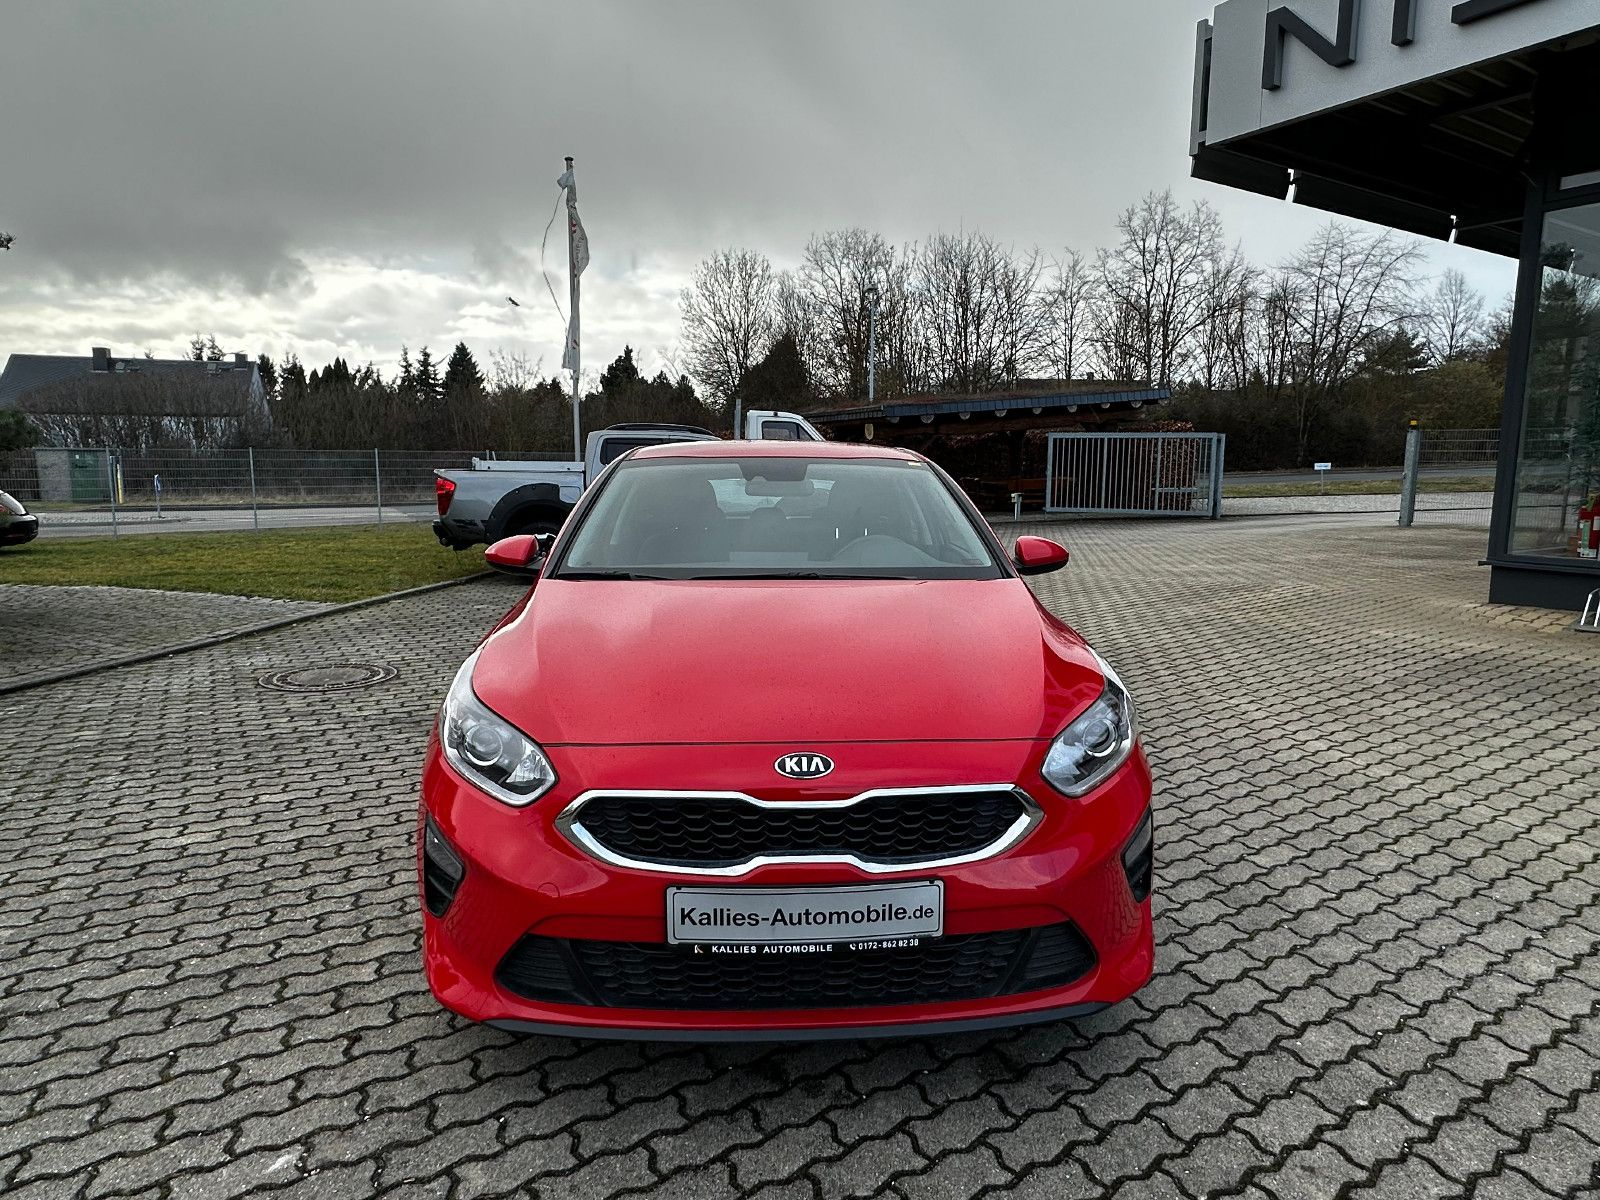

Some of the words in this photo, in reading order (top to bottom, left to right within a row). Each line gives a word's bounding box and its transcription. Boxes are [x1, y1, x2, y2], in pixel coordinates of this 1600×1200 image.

[784, 757, 825, 772] KIA
[680, 904, 934, 927] Kallies-Automobile.de
[712, 945, 757, 953] KALLIES
[763, 944, 833, 953] AUTOMOBILE
